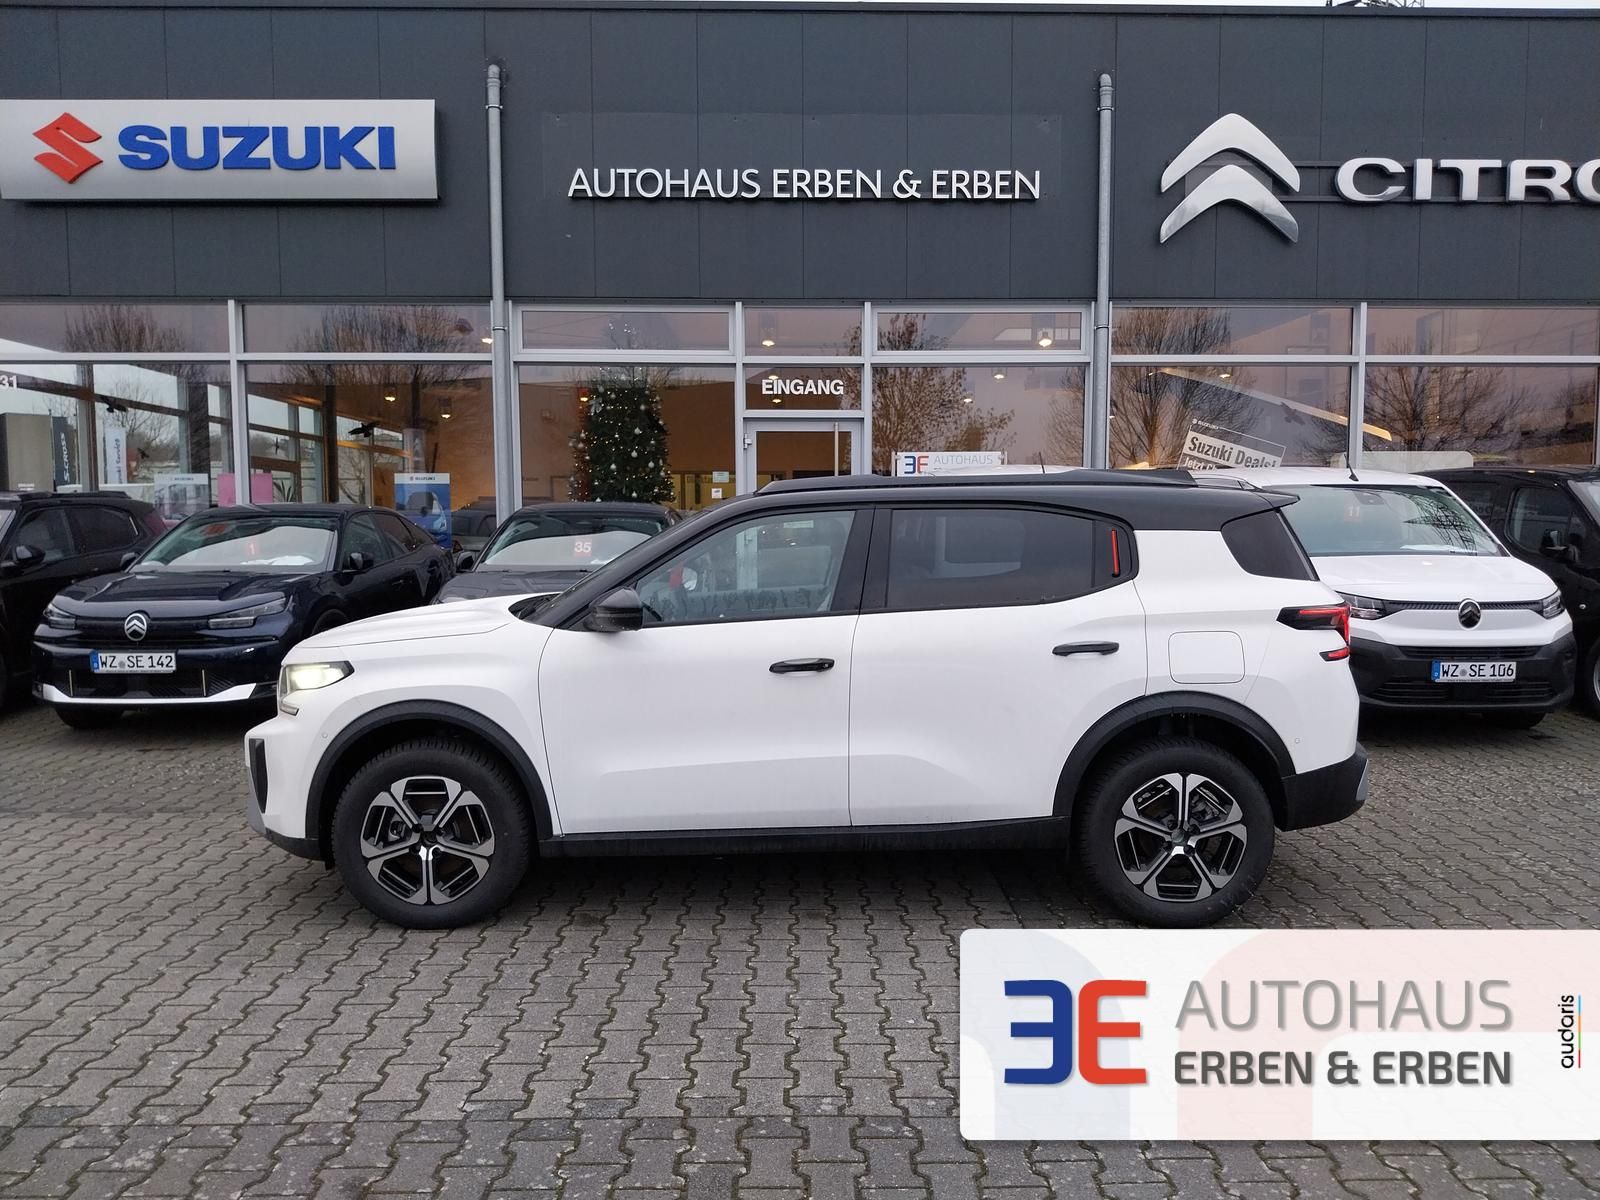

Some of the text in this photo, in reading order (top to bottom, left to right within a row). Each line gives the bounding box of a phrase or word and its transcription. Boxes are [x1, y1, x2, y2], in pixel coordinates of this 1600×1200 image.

[118, 125, 396, 170] SUZUKI
[568, 168, 1041, 199] AUTOHAUS ERBEN & ERBEN
[761, 379, 844, 395] EINGANG
[1188, 436, 1234, 462] Suzuki
[933, 455, 993, 465] AUTOHAUS
[574, 541, 592, 553] 35
[99, 655, 173, 668] WZ SE 142
[1442, 664, 1514, 677] WZ SE 106
